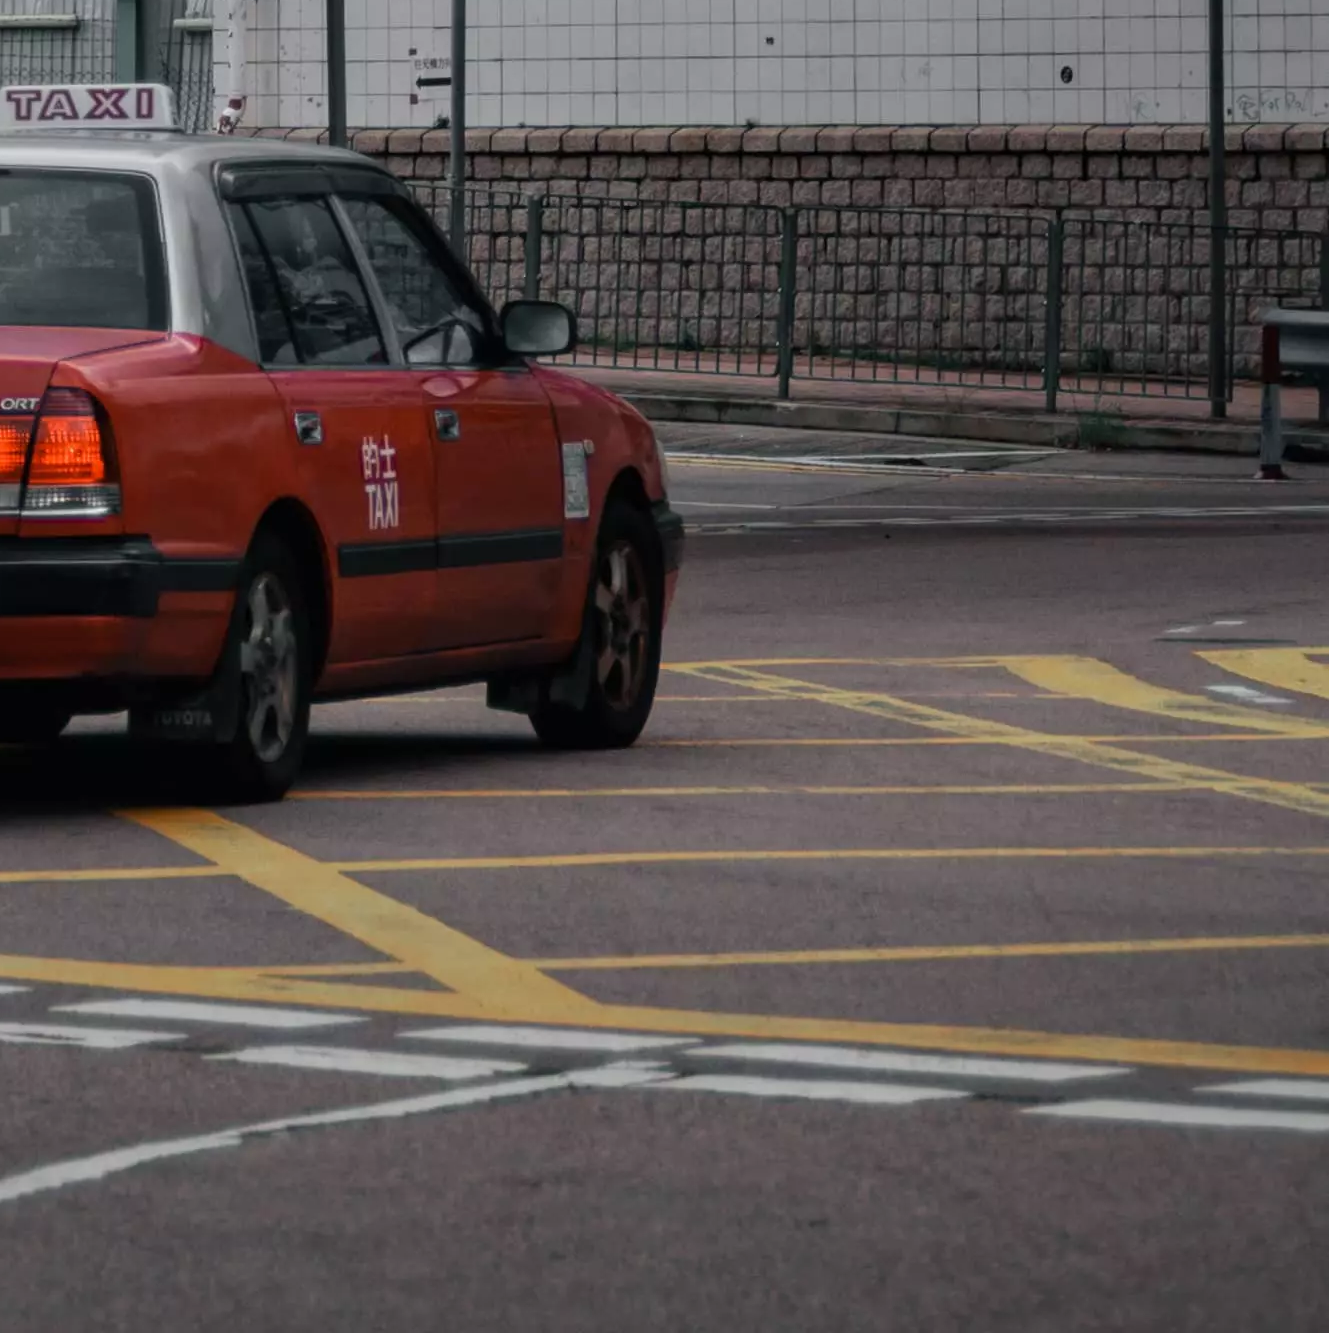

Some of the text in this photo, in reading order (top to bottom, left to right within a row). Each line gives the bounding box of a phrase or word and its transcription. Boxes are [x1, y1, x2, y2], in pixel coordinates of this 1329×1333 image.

[6, 88, 154, 121] TAXI
[361, 433, 397, 481] 的士
[364, 480, 399, 530] TAXI
